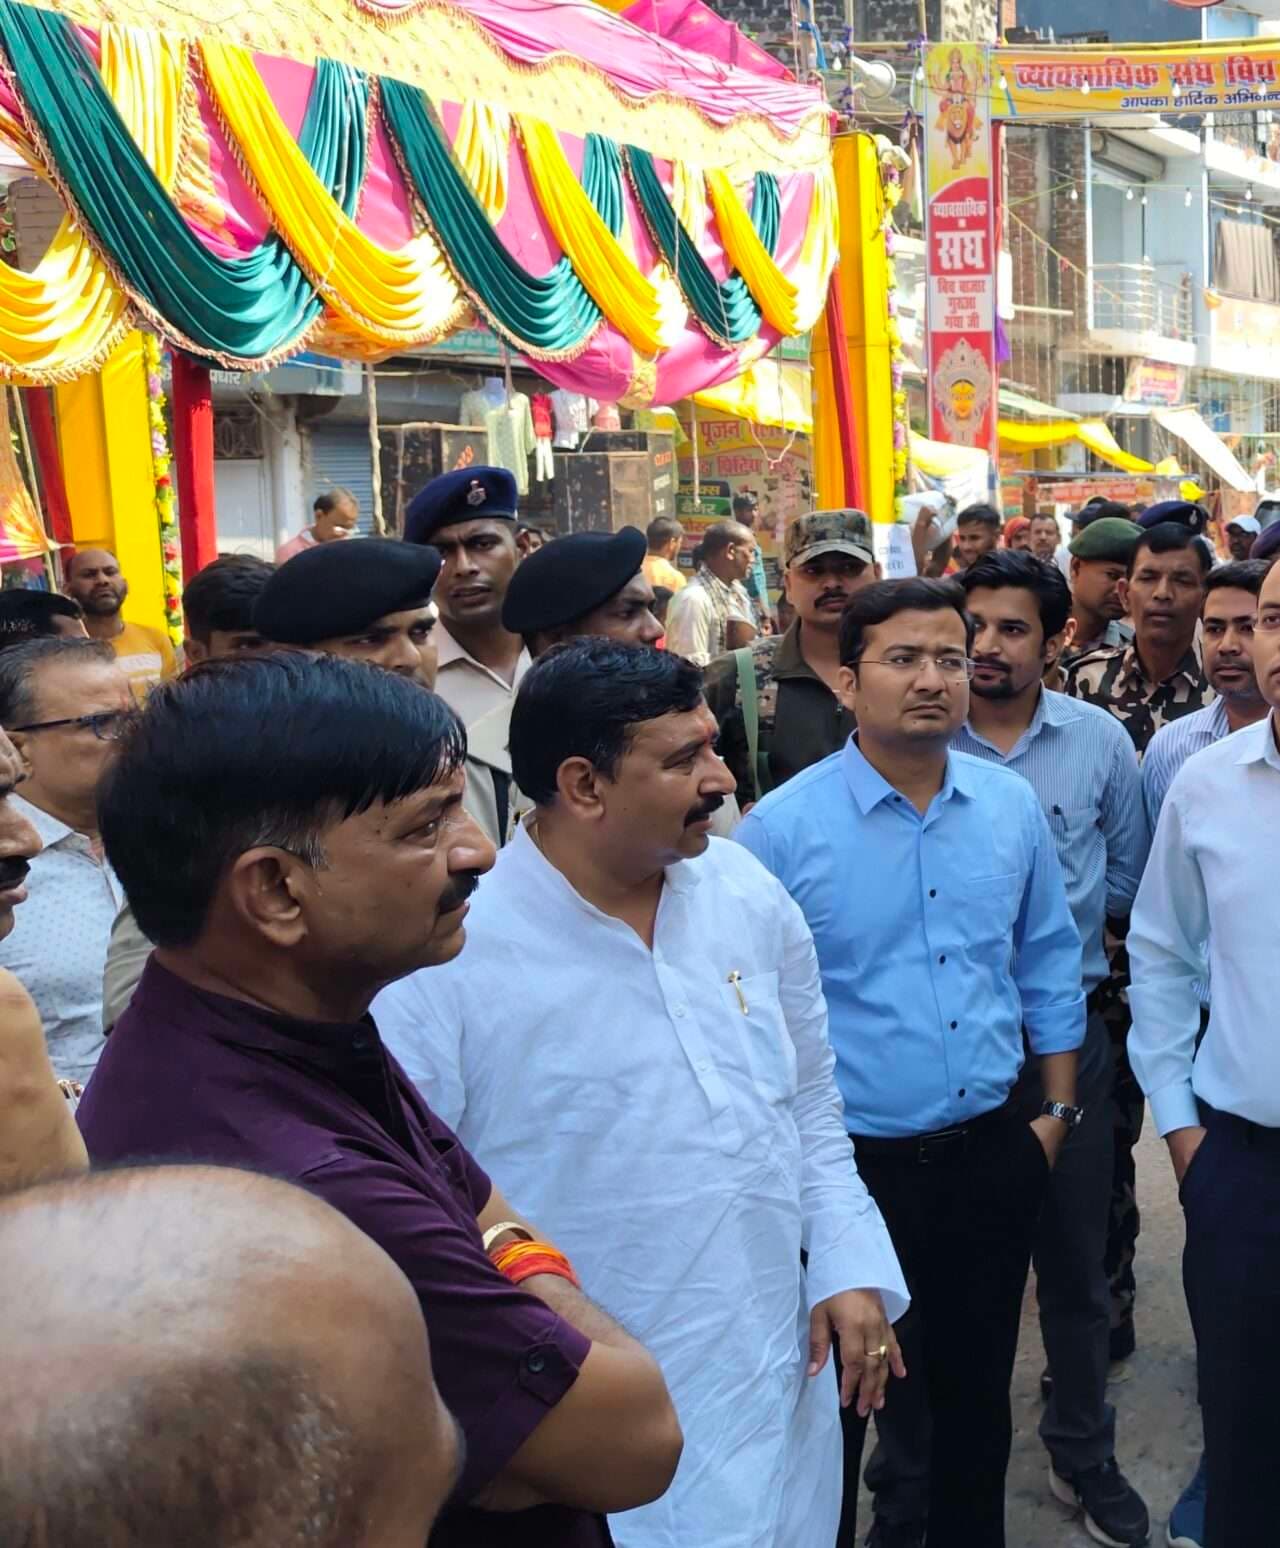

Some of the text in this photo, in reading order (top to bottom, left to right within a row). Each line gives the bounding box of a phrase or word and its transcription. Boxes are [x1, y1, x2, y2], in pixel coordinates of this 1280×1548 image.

[1014, 57, 1159, 90] व्यावसायिक
[1121, 96, 1169, 108] आपका
[1174, 90, 1218, 107] हार्दिक
[935, 218, 986, 270] संघ
